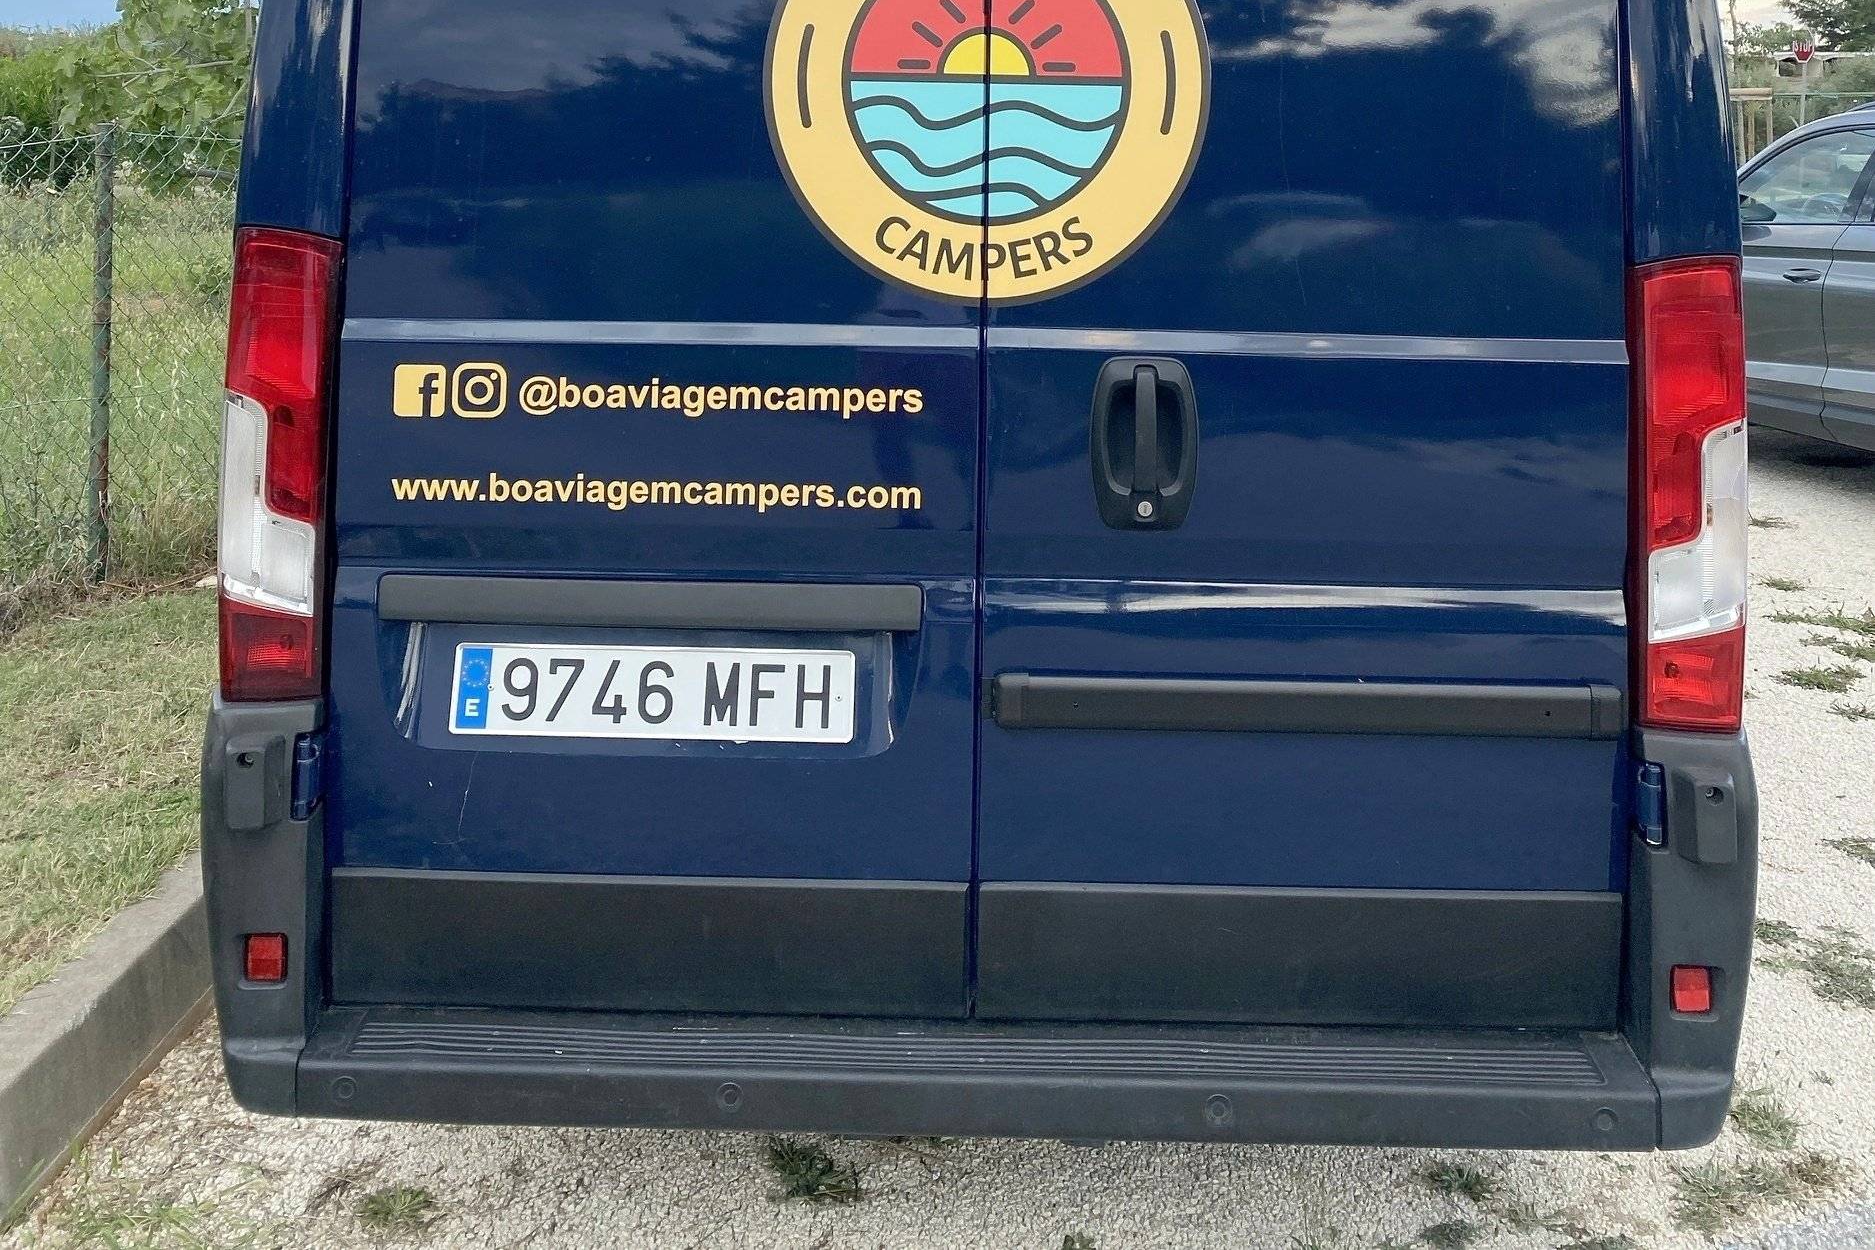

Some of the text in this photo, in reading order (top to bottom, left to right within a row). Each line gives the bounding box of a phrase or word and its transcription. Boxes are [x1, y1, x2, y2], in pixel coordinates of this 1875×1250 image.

[875, 216, 1094, 281] CAMPERS
[519, 375, 924, 419] @boaviagemcampers
[391, 472, 921, 513] www.boaviagemcampers.com
[464, 698, 481, 717] E
[501, 657, 831, 729] 9746 MFH
